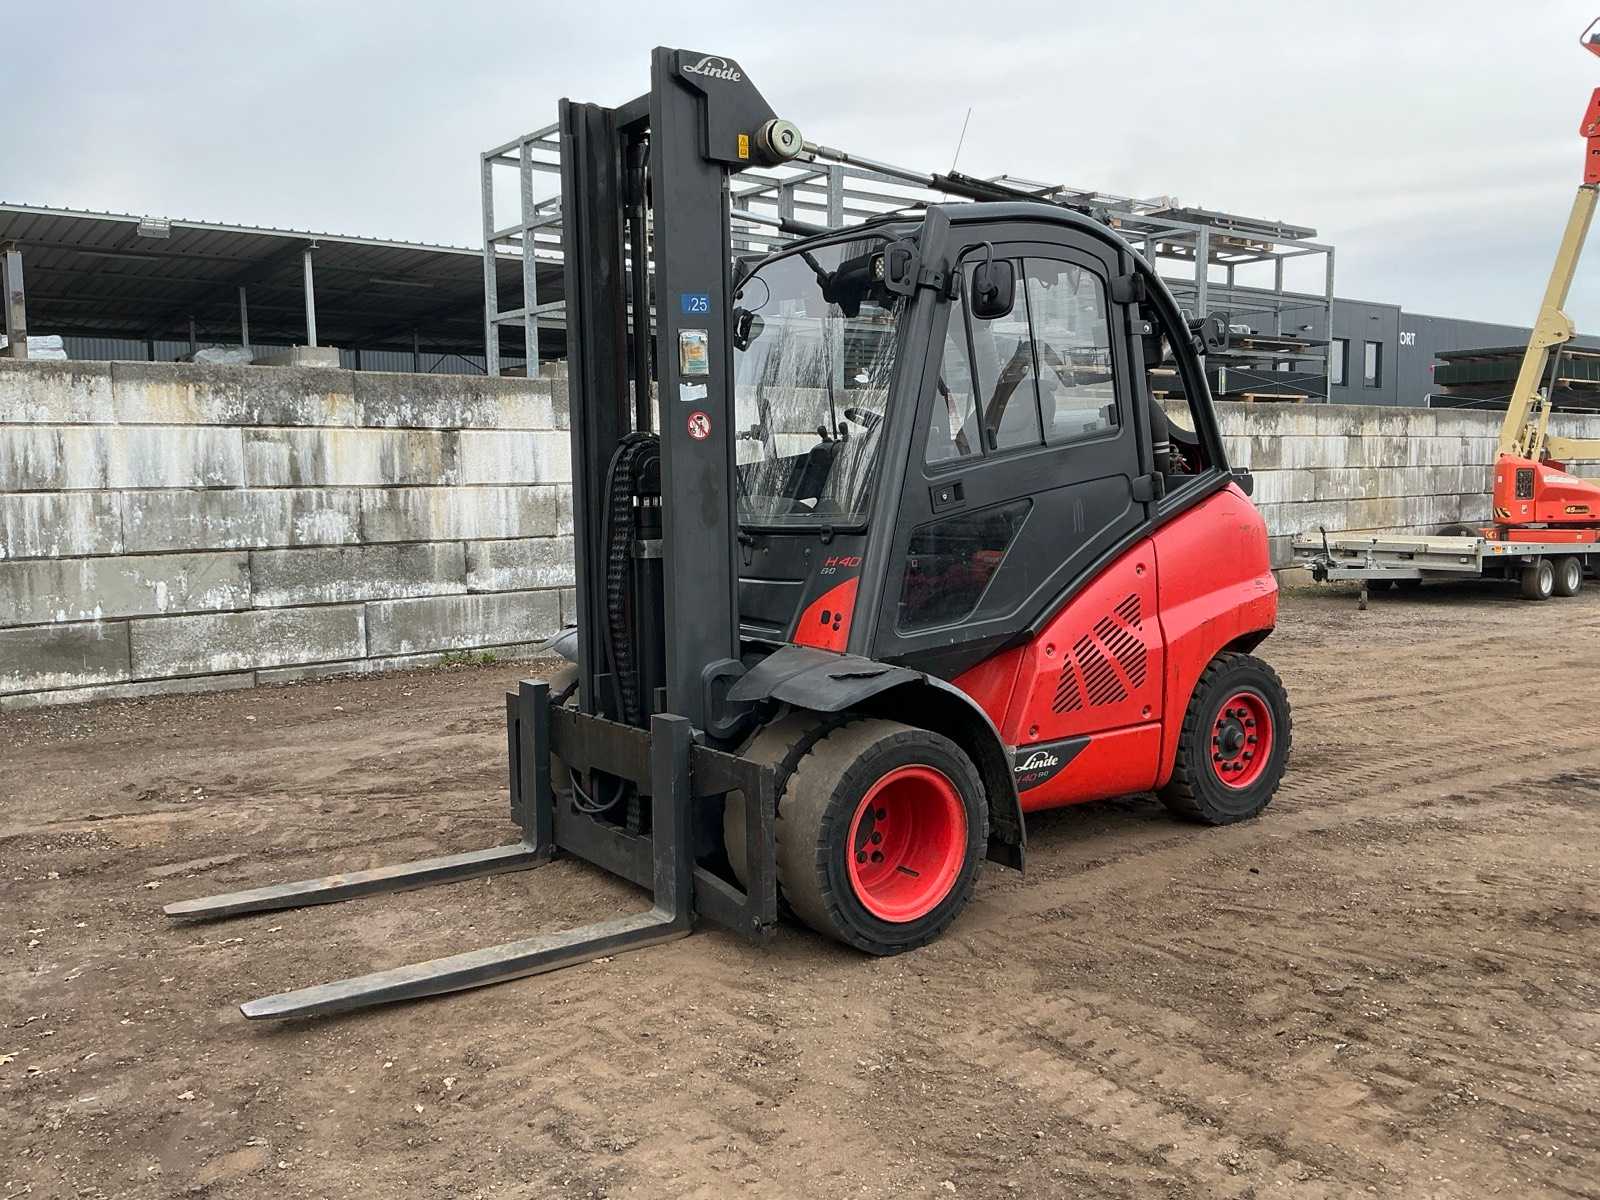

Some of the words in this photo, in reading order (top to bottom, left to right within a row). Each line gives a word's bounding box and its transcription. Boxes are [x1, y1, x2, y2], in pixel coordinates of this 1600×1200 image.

[682, 56, 741, 82] Linde
[1400, 331, 1416, 346] ORT
[1014, 751, 1059, 771] Linde
